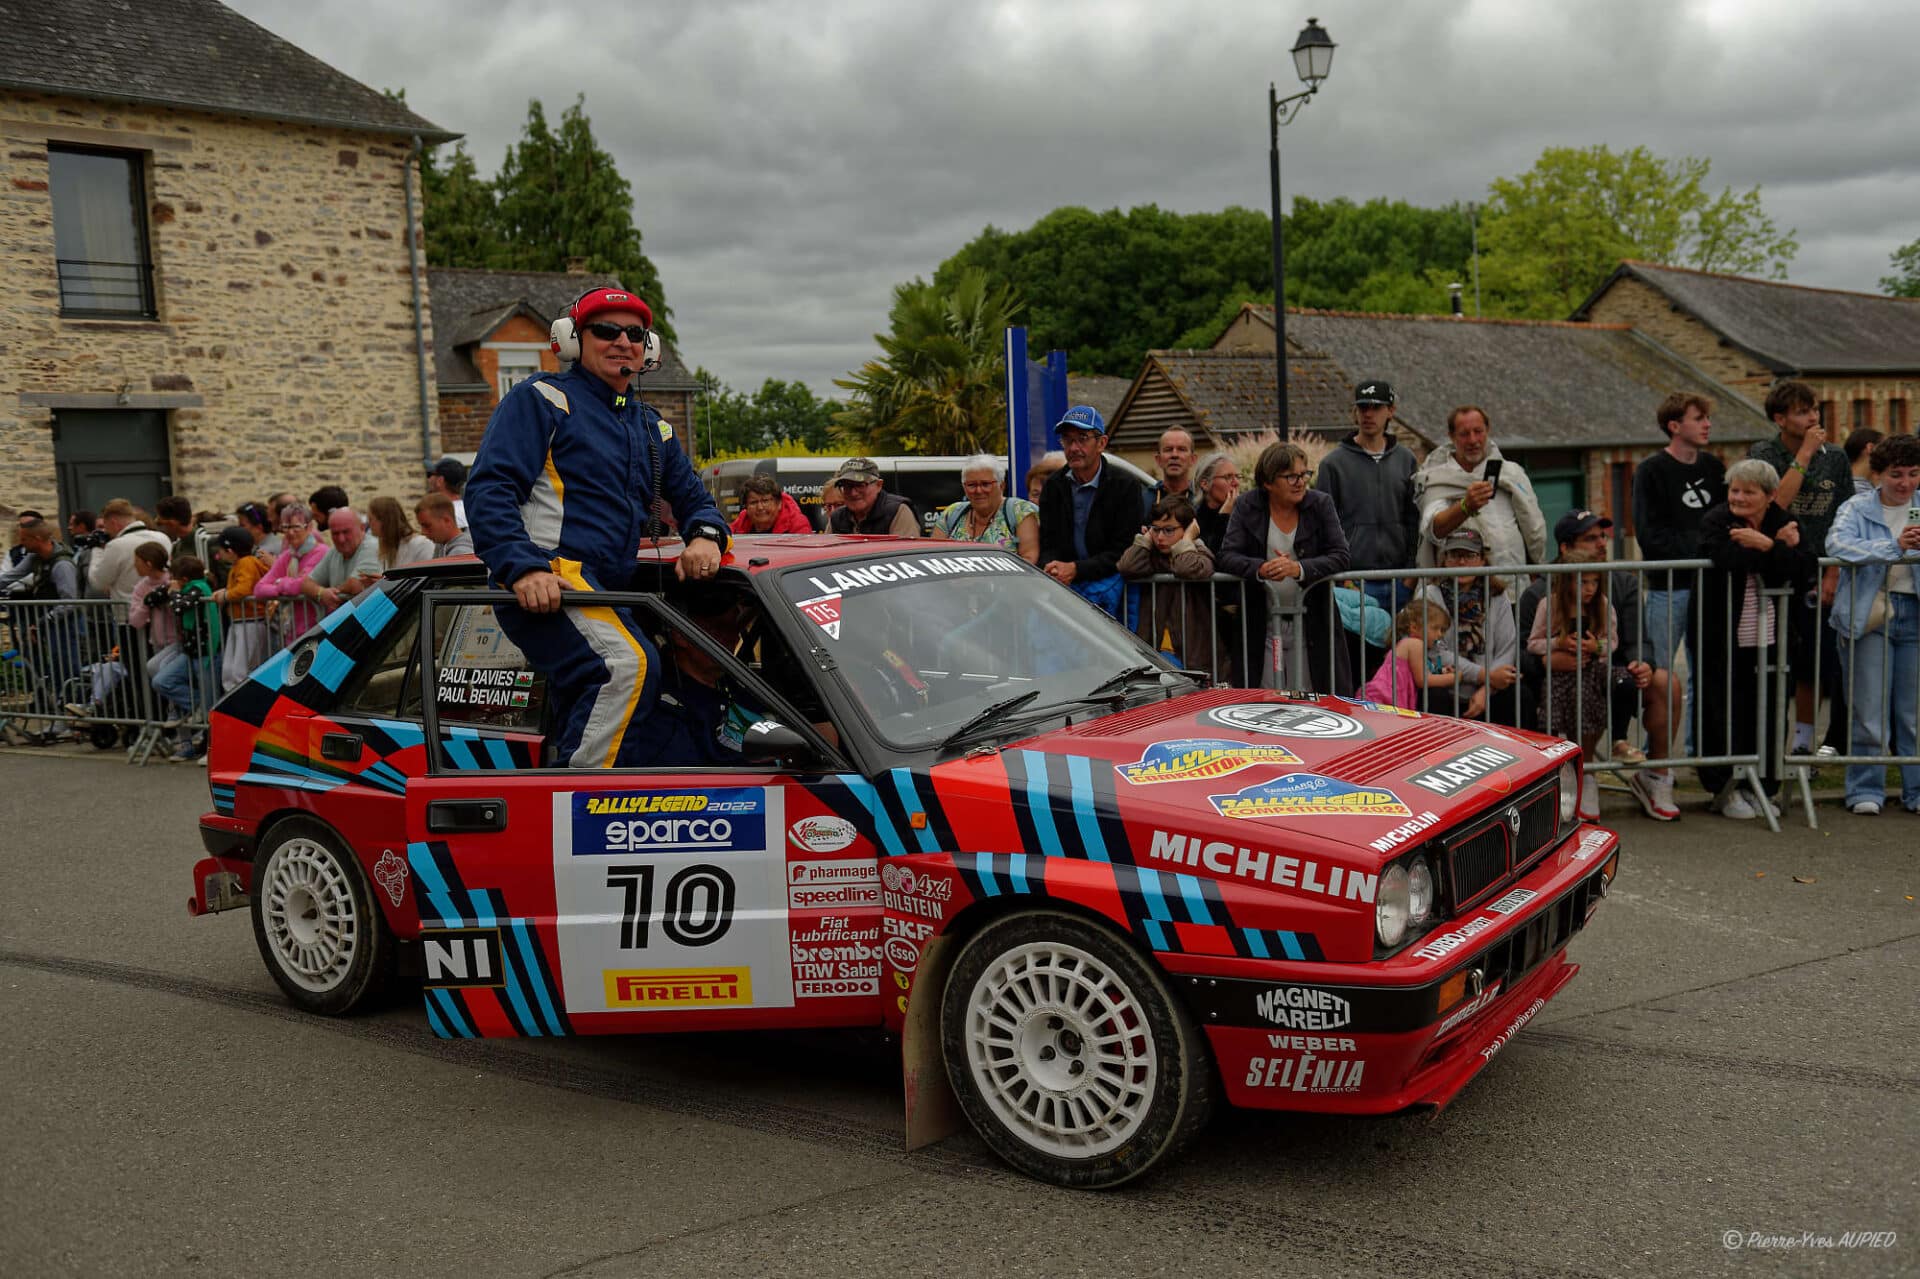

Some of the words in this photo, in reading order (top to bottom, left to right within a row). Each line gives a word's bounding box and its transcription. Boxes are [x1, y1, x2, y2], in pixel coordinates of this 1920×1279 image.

[808, 561, 928, 594] LANCIA
[918, 556, 1024, 575] MARTINI
[805, 603, 839, 622] 115
[438, 668, 468, 684] PAUL
[471, 669, 515, 687] DAVIES
[437, 686, 466, 703] PAUL
[469, 687, 511, 706] BEVAN
[1127, 748, 1285, 776] RALLYLEGEND
[1131, 755, 1248, 783] COMPETITOR
[1415, 746, 1515, 794] MARTINI
[586, 795, 708, 815] RALLYLEGEND
[706, 801, 757, 812] 2022
[1220, 791, 1392, 809] RALLYLEGEND
[1226, 804, 1352, 817] COMPETITOR
[1358, 804, 1409, 815] 2022
[605, 818, 732, 851] sparco
[1370, 811, 1440, 853] MICHELIN
[1149, 830, 1379, 904] MICHELIN
[793, 888, 878, 906] speedline
[916, 874, 952, 901] 4x4
[606, 864, 736, 949] 10
[884, 891, 943, 920] BILSTEIN
[792, 928, 879, 943] Lubrificanti
[820, 916, 849, 929] Fiat
[883, 917, 934, 941] SKF
[423, 939, 492, 979] NI
[792, 942, 884, 963] brembo
[1412, 932, 1467, 961] TURBO
[793, 963, 834, 979] TRW
[839, 960, 882, 978] Sabel
[616, 974, 738, 1001] PIRELLI
[801, 981, 873, 993] FERODO
[1256, 987, 1350, 1023] MAGNETI
[1256, 990, 1350, 1031] MARELLI
[1267, 1034, 1357, 1051] WEBER
